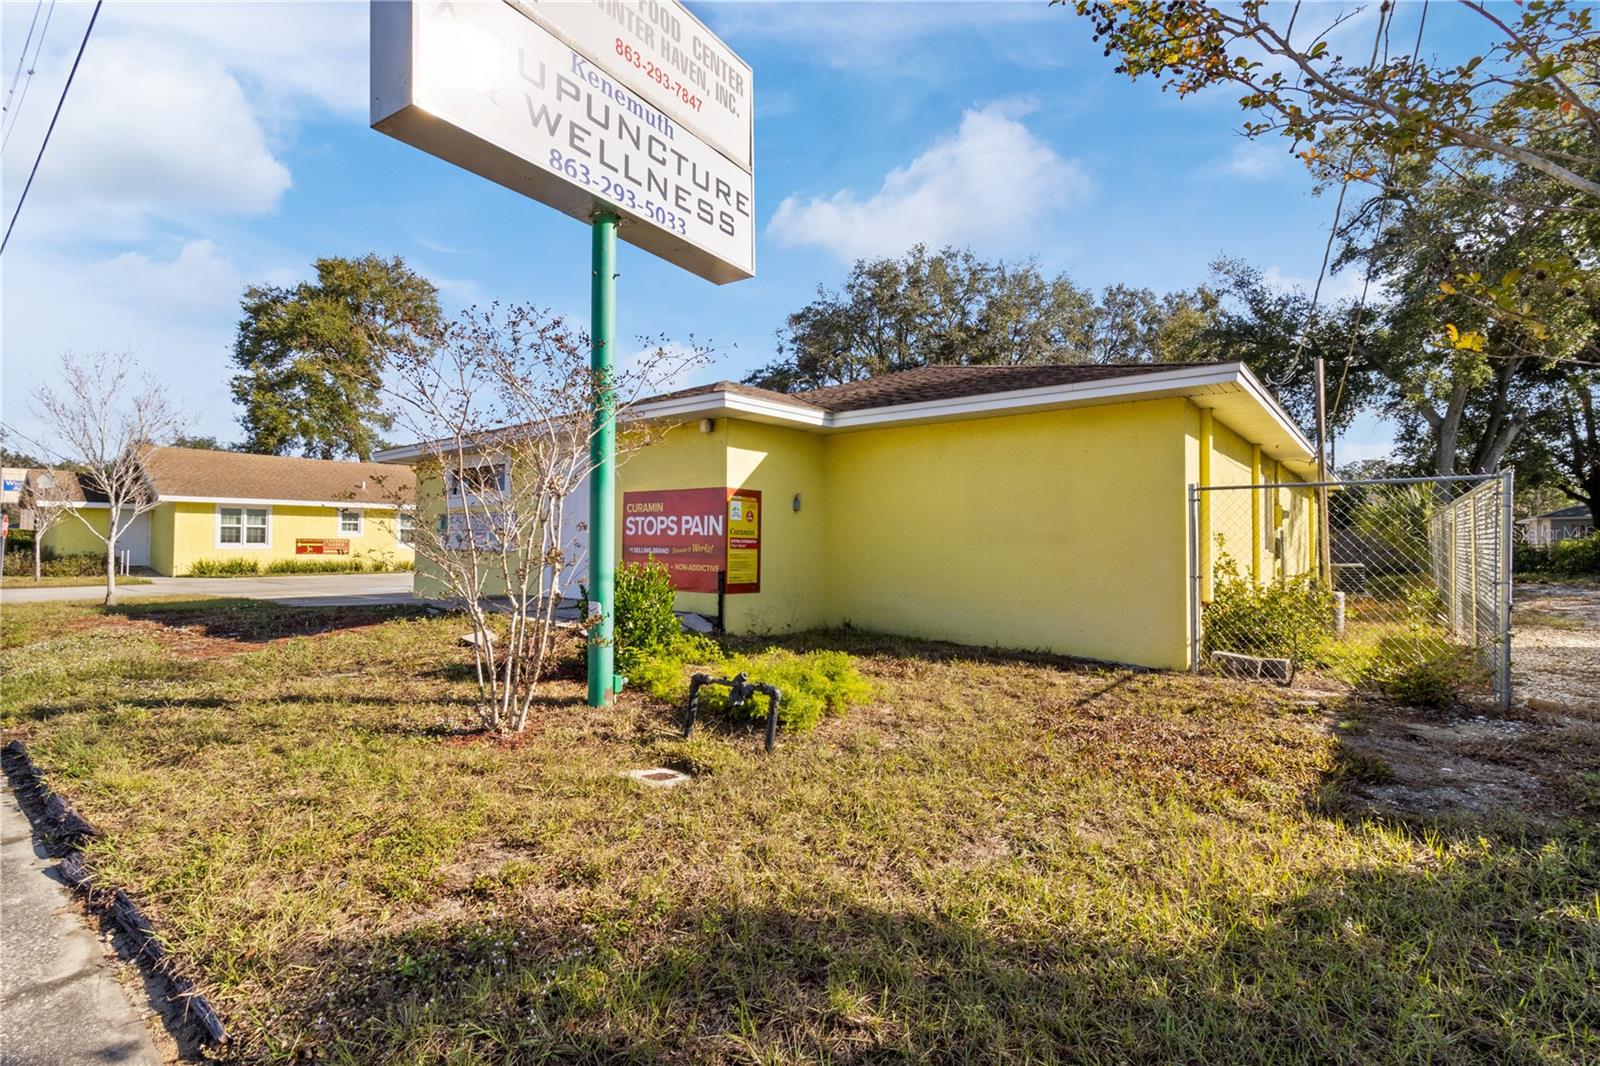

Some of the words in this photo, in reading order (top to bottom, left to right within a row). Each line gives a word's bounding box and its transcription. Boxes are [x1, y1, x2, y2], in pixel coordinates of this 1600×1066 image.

[569, 51, 676, 140] Kenemuth
[615, 37, 704, 113] 863-293-7847
[660, 37, 711, 97] HAVEN,
[715, 84, 741, 118] INC.
[692, 35, 744, 97] CENTER
[431, 0, 750, 218] AUPUNCTURE
[524, 92, 736, 237] WELLNESS
[548, 148, 687, 236] 863-293-5033
[625, 515, 678, 536] STOPS
[681, 515, 724, 536] PAIN
[626, 502, 664, 513] CURAMIN
[652, 546, 670, 554] BRAND
[674, 563, 720, 573] NON-ADDICTIVE
